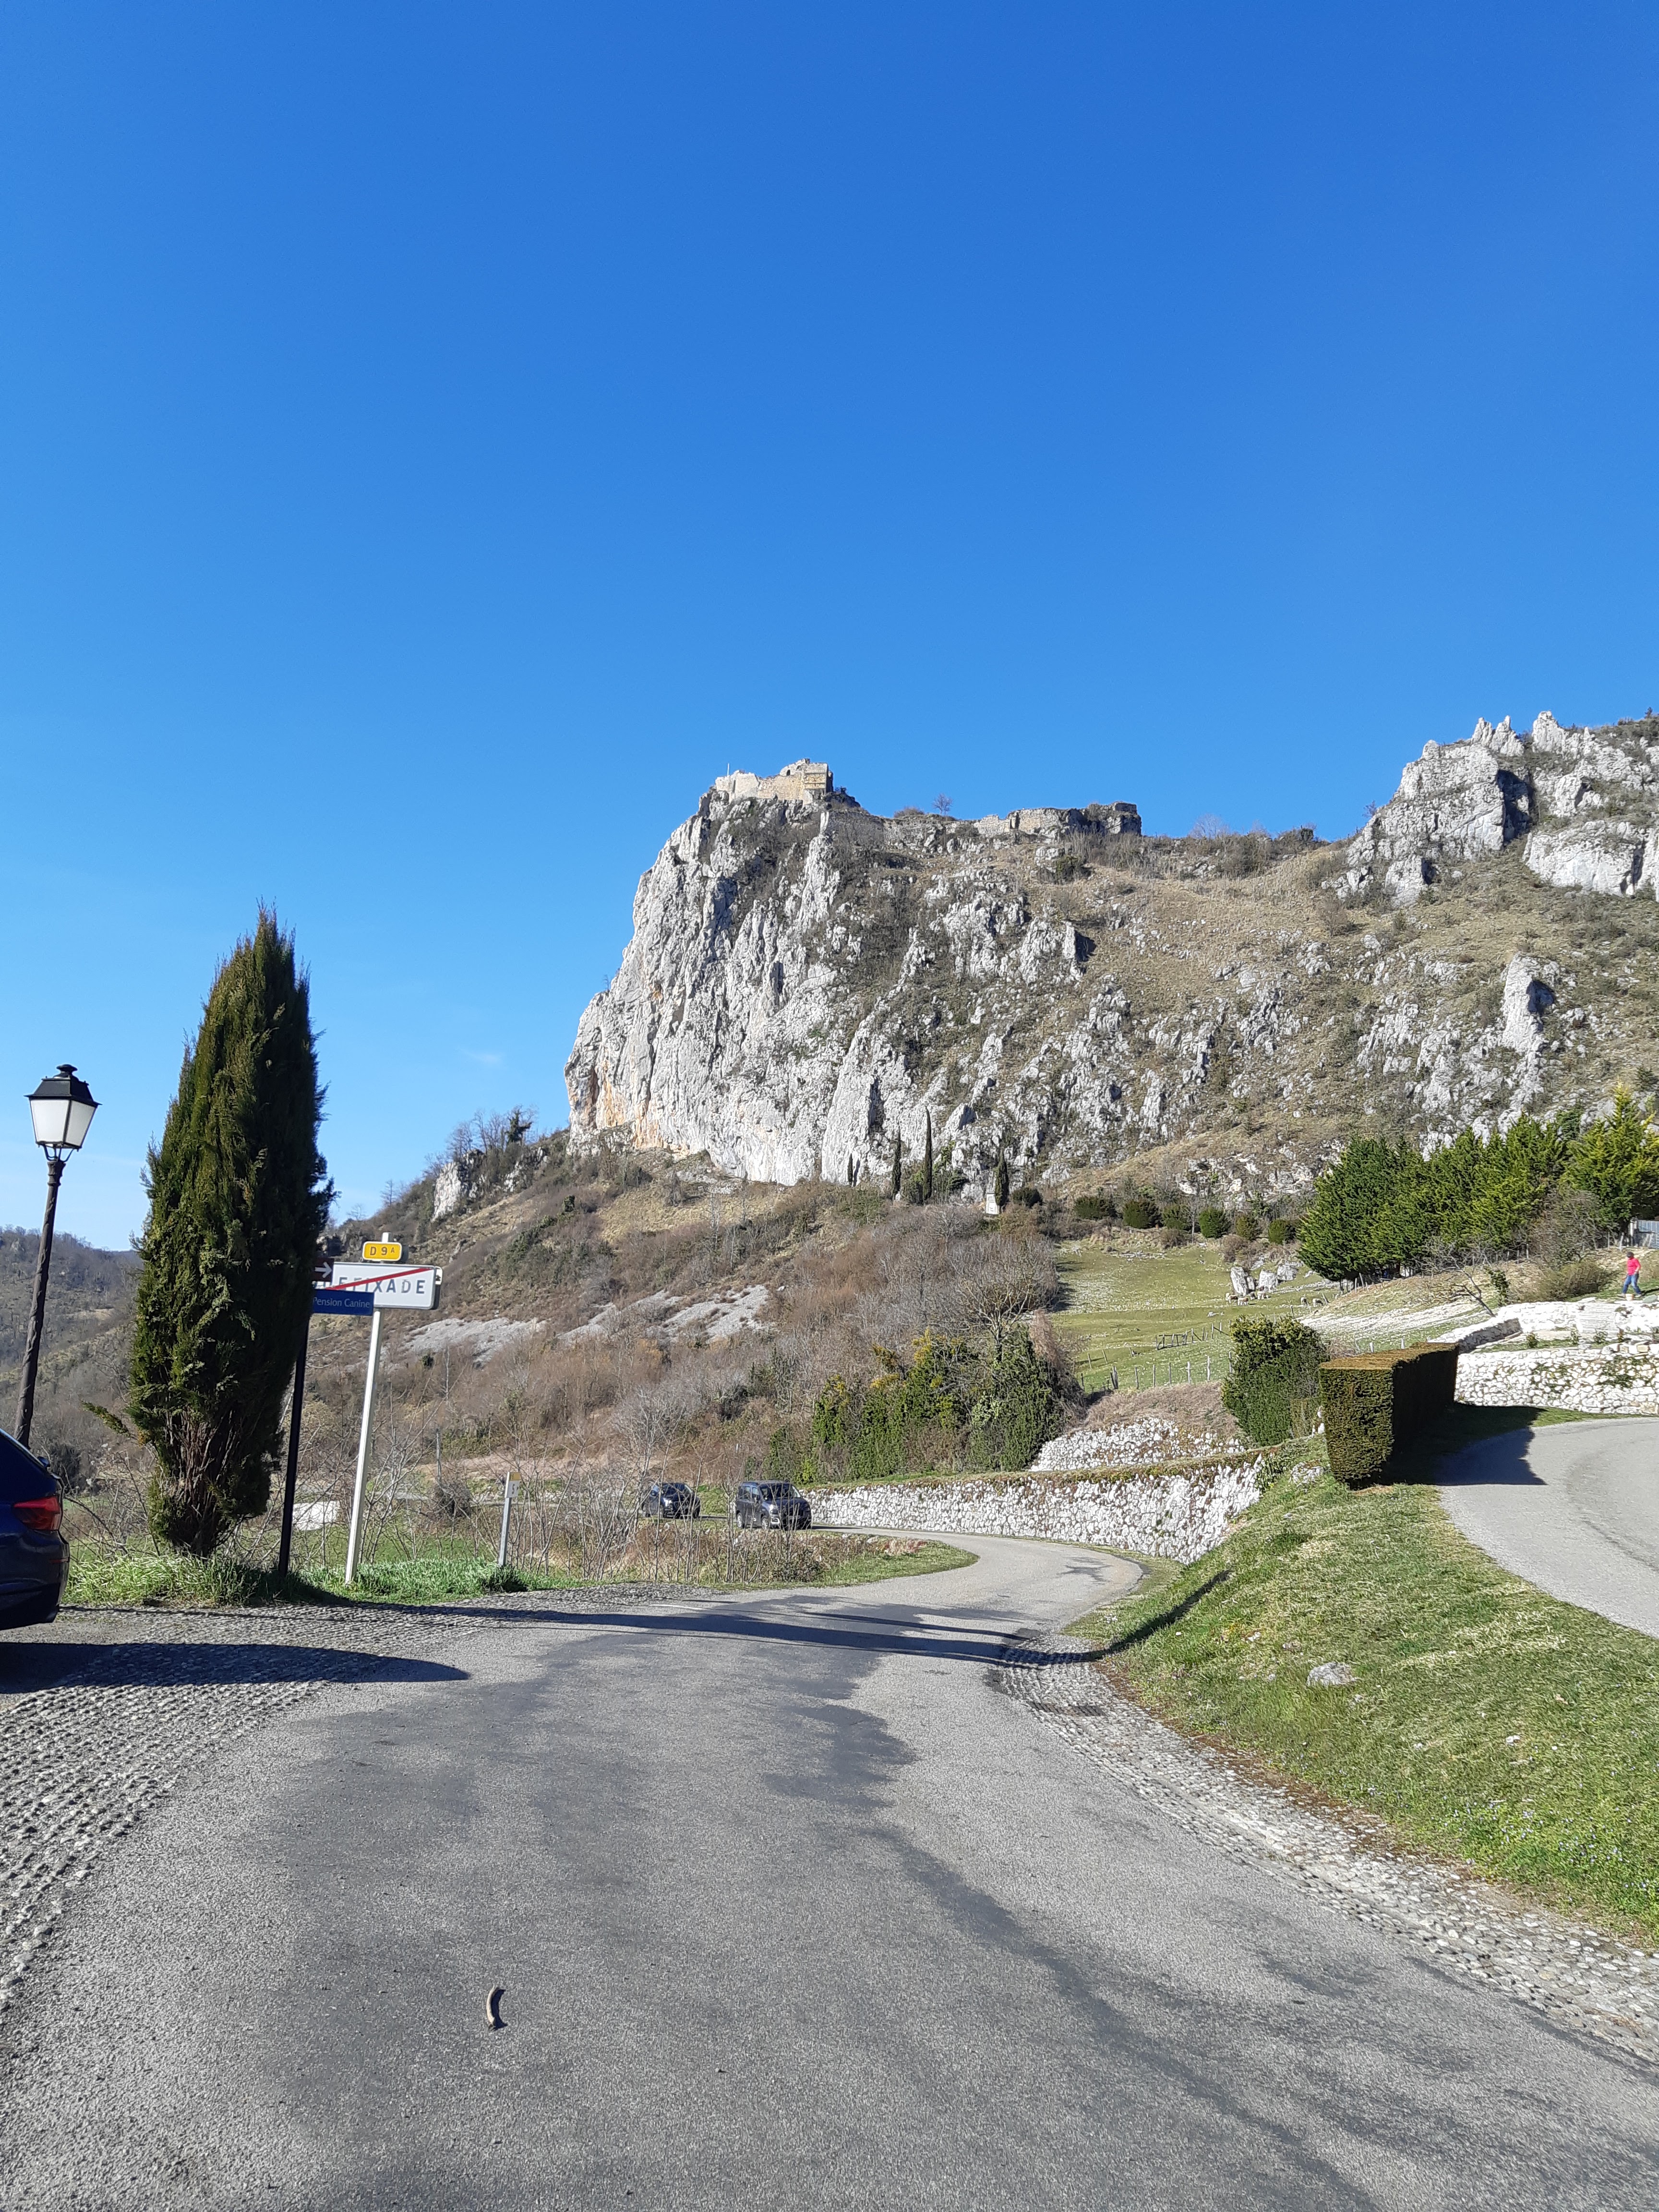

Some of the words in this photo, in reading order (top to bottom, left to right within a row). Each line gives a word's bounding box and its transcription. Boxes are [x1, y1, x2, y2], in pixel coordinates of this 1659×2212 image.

[370, 1246, 376, 1256] D
[313, 1297, 342, 1307] Pension
[344, 1298, 370, 1308] Canine
